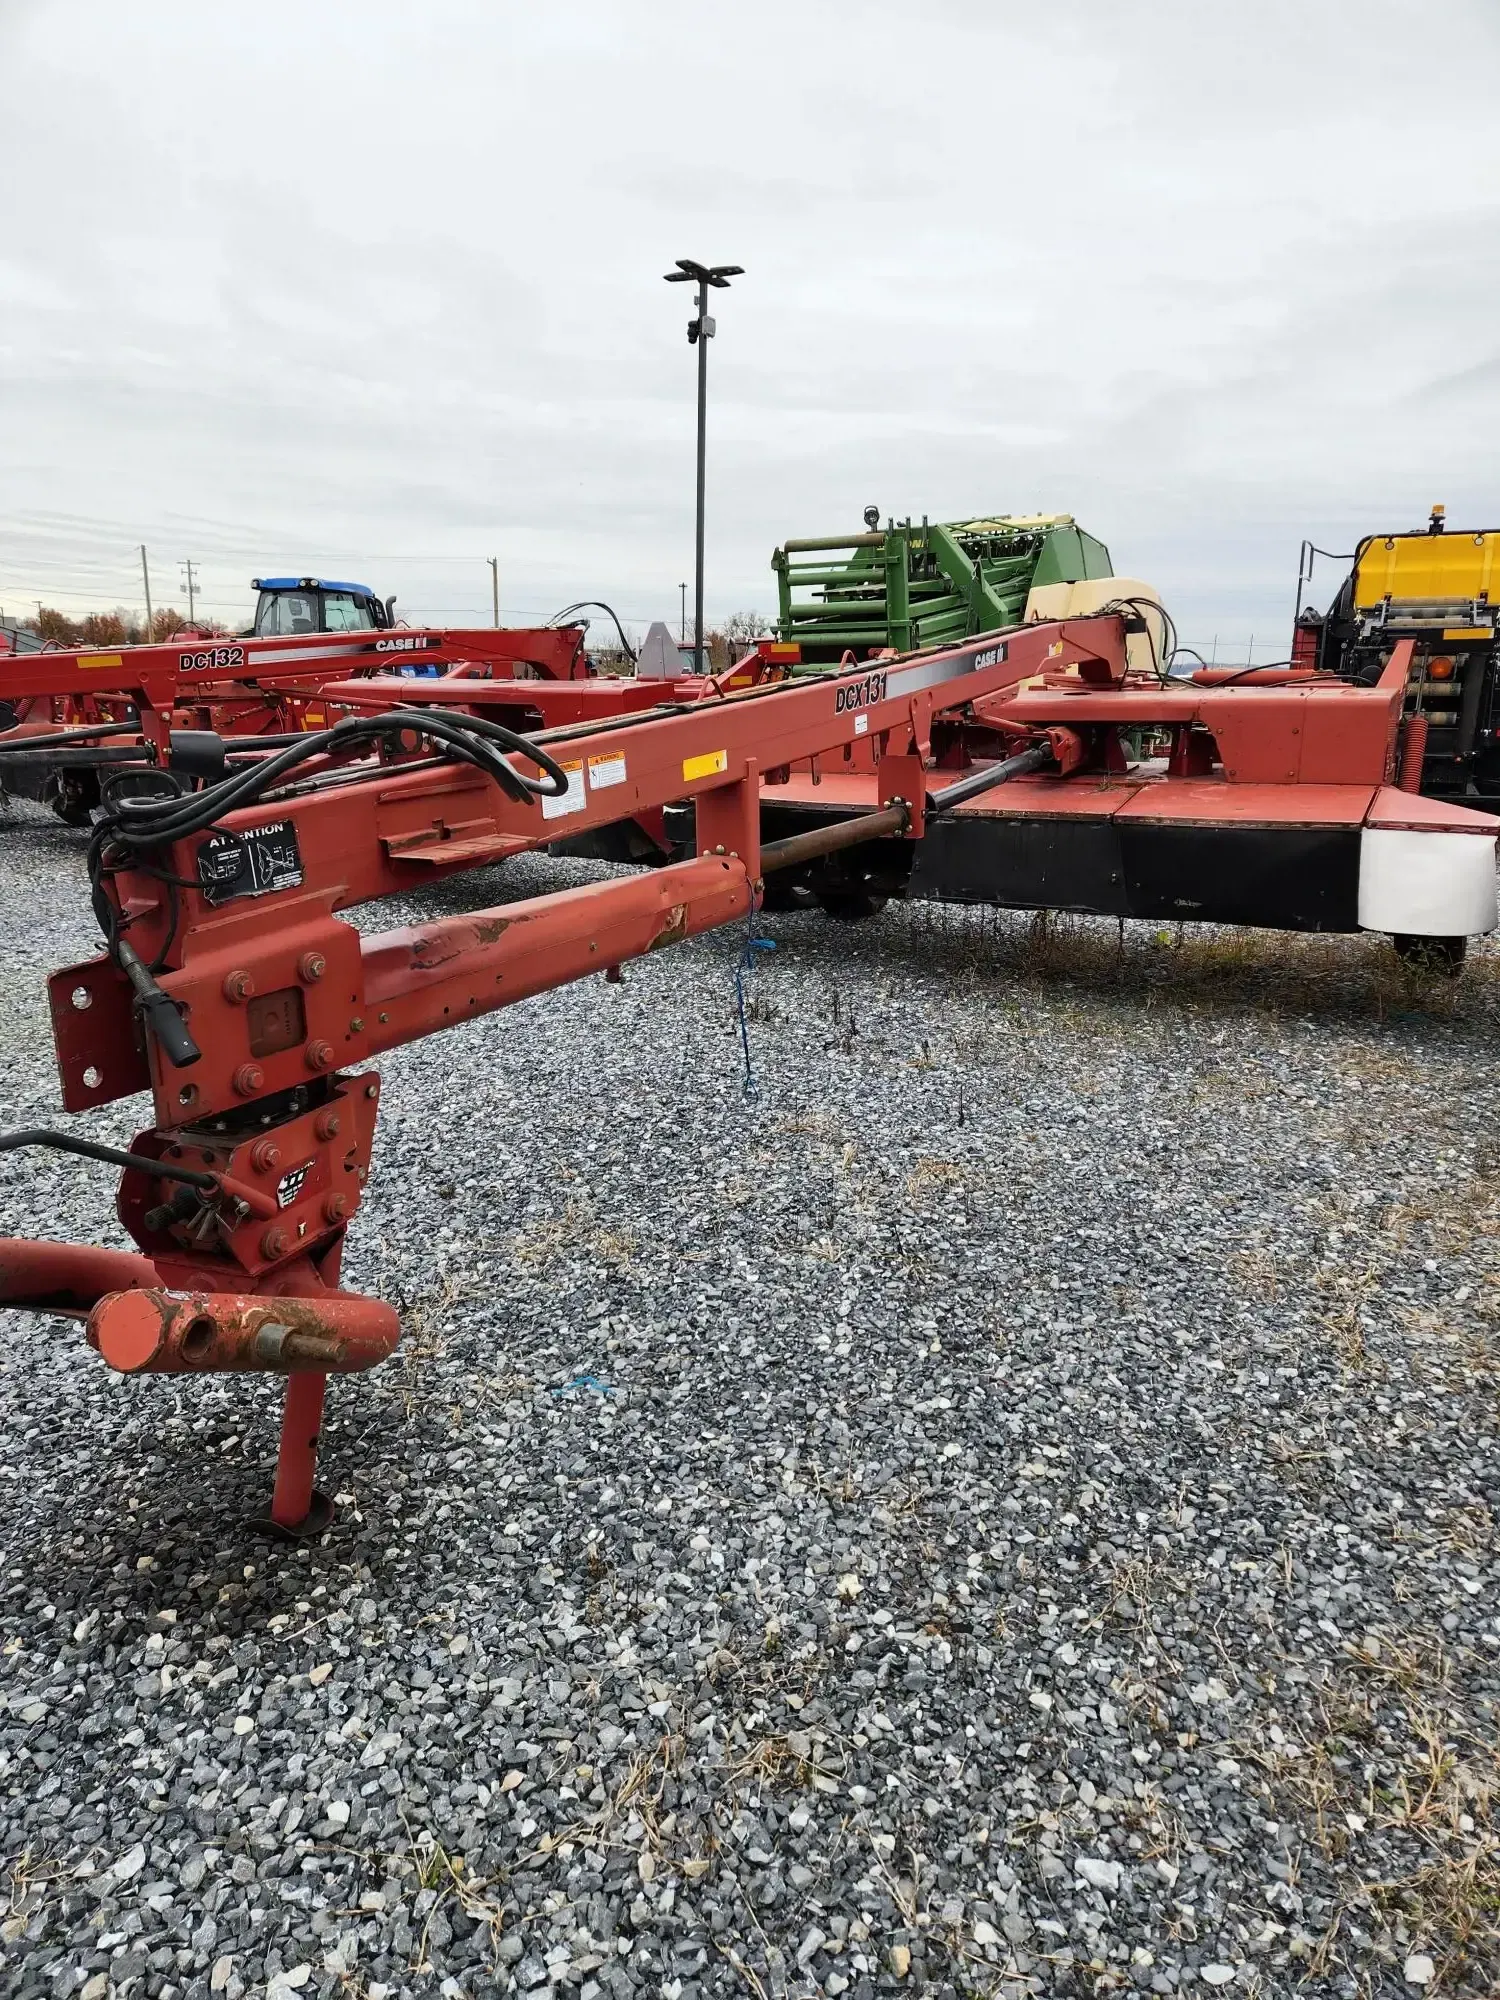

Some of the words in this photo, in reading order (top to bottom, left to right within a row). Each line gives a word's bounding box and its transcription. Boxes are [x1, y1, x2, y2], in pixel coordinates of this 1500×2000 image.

[375, 638, 414, 652] CASE
[180, 647, 244, 671] DC132
[975, 650, 997, 670] CASE
[835, 670, 888, 714] DCX131
[209, 823, 284, 848] ATNTION
